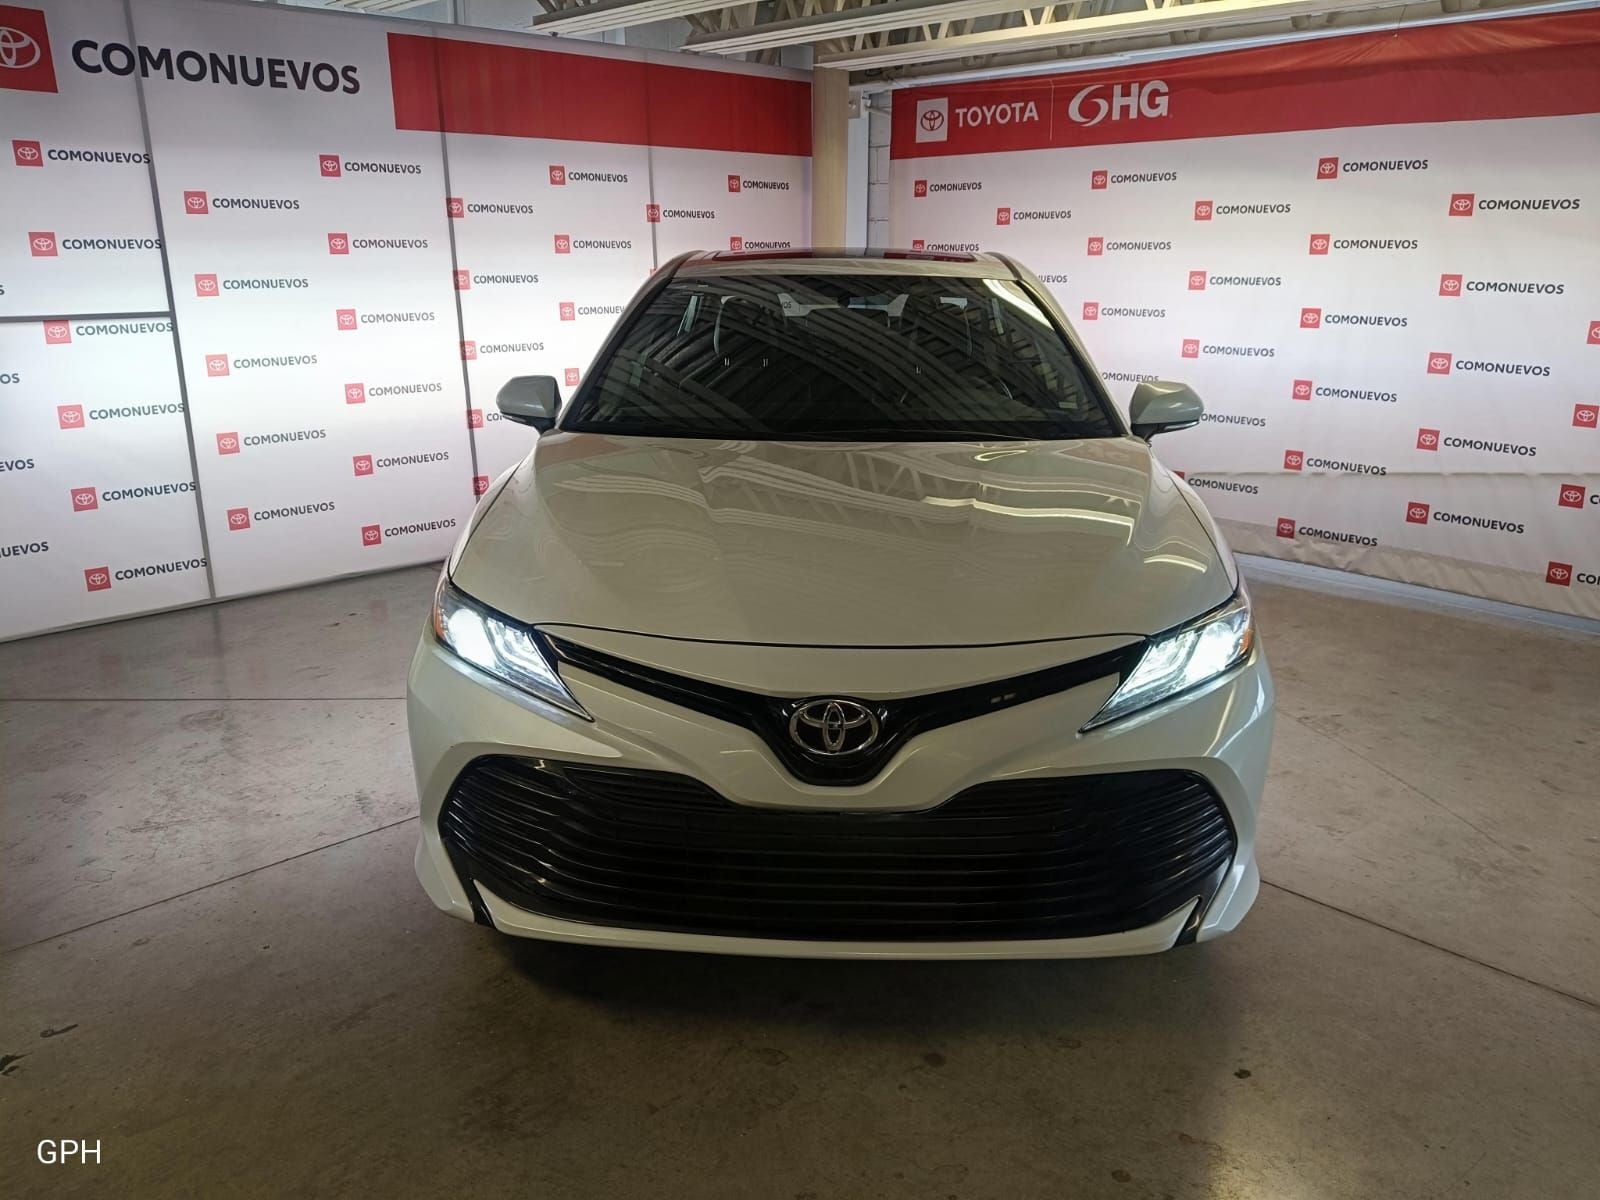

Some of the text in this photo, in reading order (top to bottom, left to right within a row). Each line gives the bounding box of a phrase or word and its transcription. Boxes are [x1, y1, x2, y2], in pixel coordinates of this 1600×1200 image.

[72, 39, 360, 94] COMONUEVOS
[956, 101, 1040, 128] TOYOTA
[48, 149, 151, 165] COMONUEVOS
[345, 162, 421, 174] COMONUEVOS
[1343, 160, 1428, 172] COMONUEVOS
[569, 172, 627, 182] COMONUEVOS
[1111, 172, 1176, 183] COMONUEVOS
[743, 181, 789, 190] COMONUEVOS
[930, 182, 982, 192] COMONUEVOS
[213, 198, 299, 209] COMONUEVOS
[467, 204, 533, 213] COMONUEVOS
[1216, 204, 1290, 214] COMONUEVOS
[1479, 199, 1580, 210] COMONUEVOS
[663, 210, 715, 219] COMONUEVOS
[1014, 211, 1071, 220] COMONUEVOS
[62, 238, 162, 250] COMONUEVOS
[353, 240, 428, 248] COMONUEVOS
[573, 240, 631, 248] COMONUEVOS
[1106, 242, 1171, 250] COMONUEVOS
[1334, 240, 1418, 249] COMONUEVOS
[223, 279, 308, 289] COMONUEVOS
[474, 275, 538, 284] COMONUEVOS
[1038, 275, 1068, 284] UEVOS
[1210, 277, 1281, 286] COMONUEVOS
[1467, 281, 1564, 294] COMONUEVOS
[361, 312, 435, 323] COMONUEVOS
[578, 306, 625, 317] COMONUEV
[1101, 308, 1165, 317] COMONUEVOS
[1325, 315, 1407, 327] COMONUEVOS
[76, 322, 173, 336] COMONUEVOS
[480, 342, 544, 353] COMONUEVOS
[1203, 346, 1274, 357] COMONUEVOS
[233, 355, 317, 368] COMONUEVOS
[1456, 361, 1550, 376] COMONUEVOS
[1101, 372, 1159, 382] OMONUEVOS
[369, 383, 442, 396] COMONUEVOS
[1316, 387, 1397, 402] COMONUEVOS
[89, 403, 186, 421] COMONUEVOS
[1200, 414, 1266, 427] OMONUEVOS
[244, 429, 326, 446] COMONUEVOS
[1444, 437, 1536, 456] COMONUEVOS
[377, 452, 449, 467] COMONUEVOS
[1307, 458, 1386, 476] COMONUEVOS
[102, 482, 197, 501] COMONUEVOS
[1188, 478, 1258, 494] COMONUEVOS
[254, 502, 335, 520] COMONUEVOS
[385, 518, 456, 537] COMONUEVOS
[1434, 512, 1524, 534] COMONUEVOS
[1298, 527, 1377, 547] COMONUEVOS
[0, 542, 48, 558] UEVOS
[115, 557, 208, 580] COMONUEVOS
